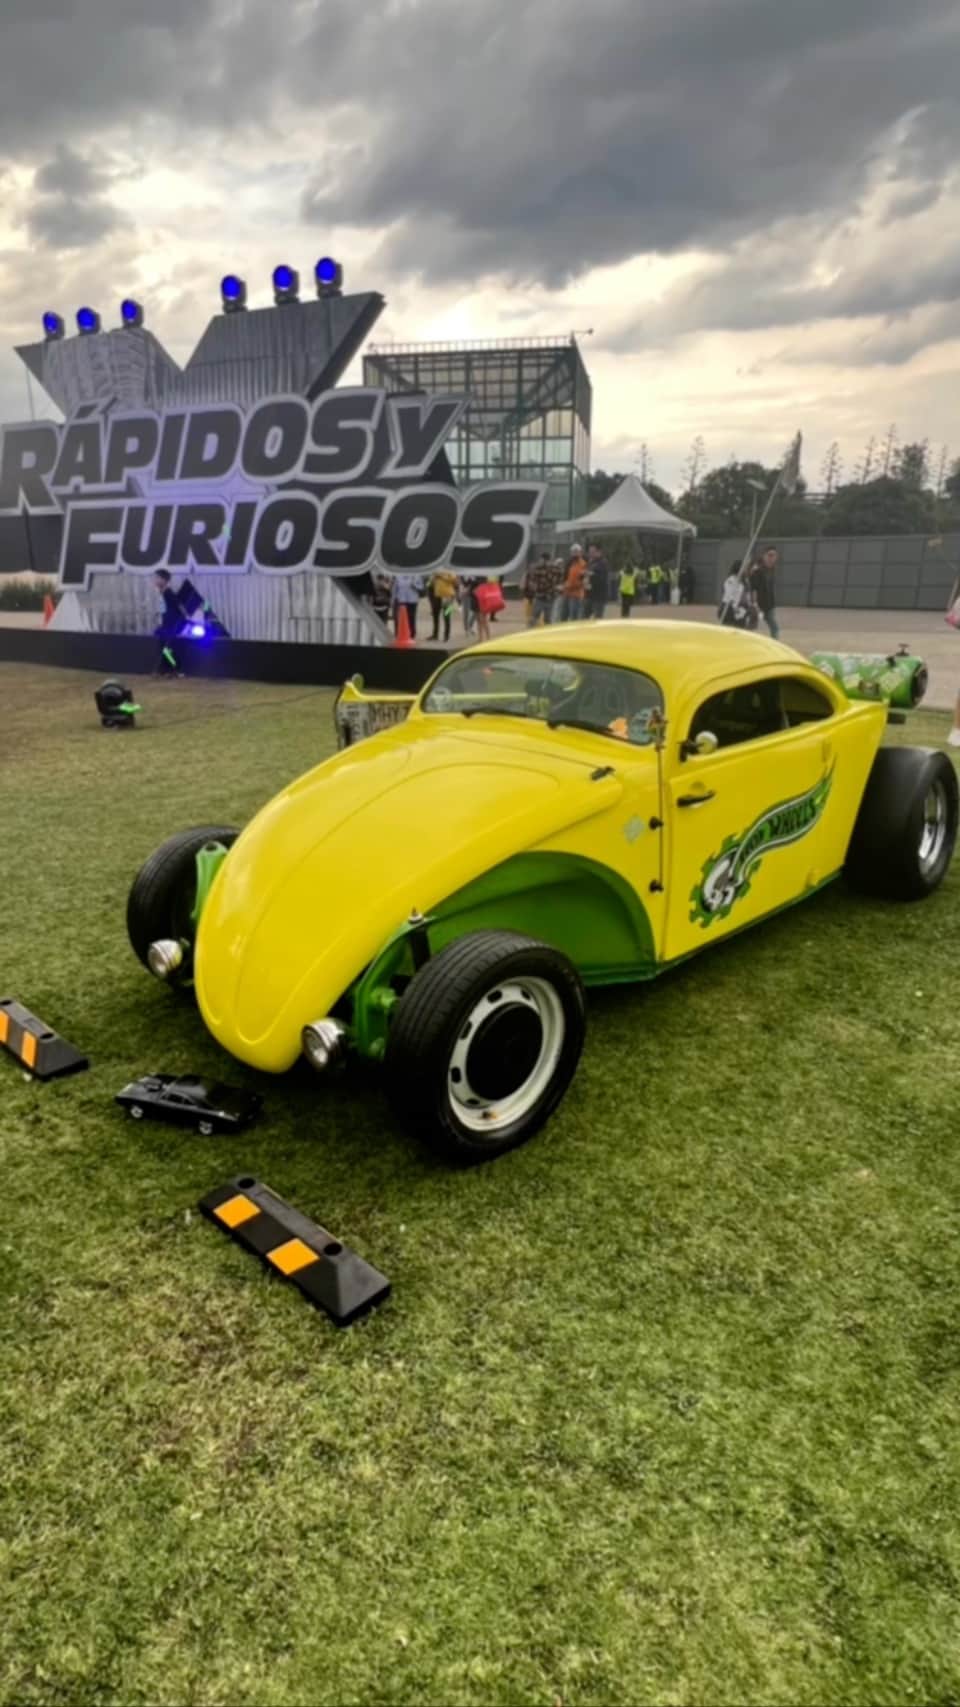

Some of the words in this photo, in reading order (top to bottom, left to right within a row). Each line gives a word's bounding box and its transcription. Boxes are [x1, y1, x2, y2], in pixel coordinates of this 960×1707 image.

[0, 390, 384, 513] RÁPIDOS
[389, 396, 468, 478] Y
[59, 483, 546, 590] FURIOSOS
